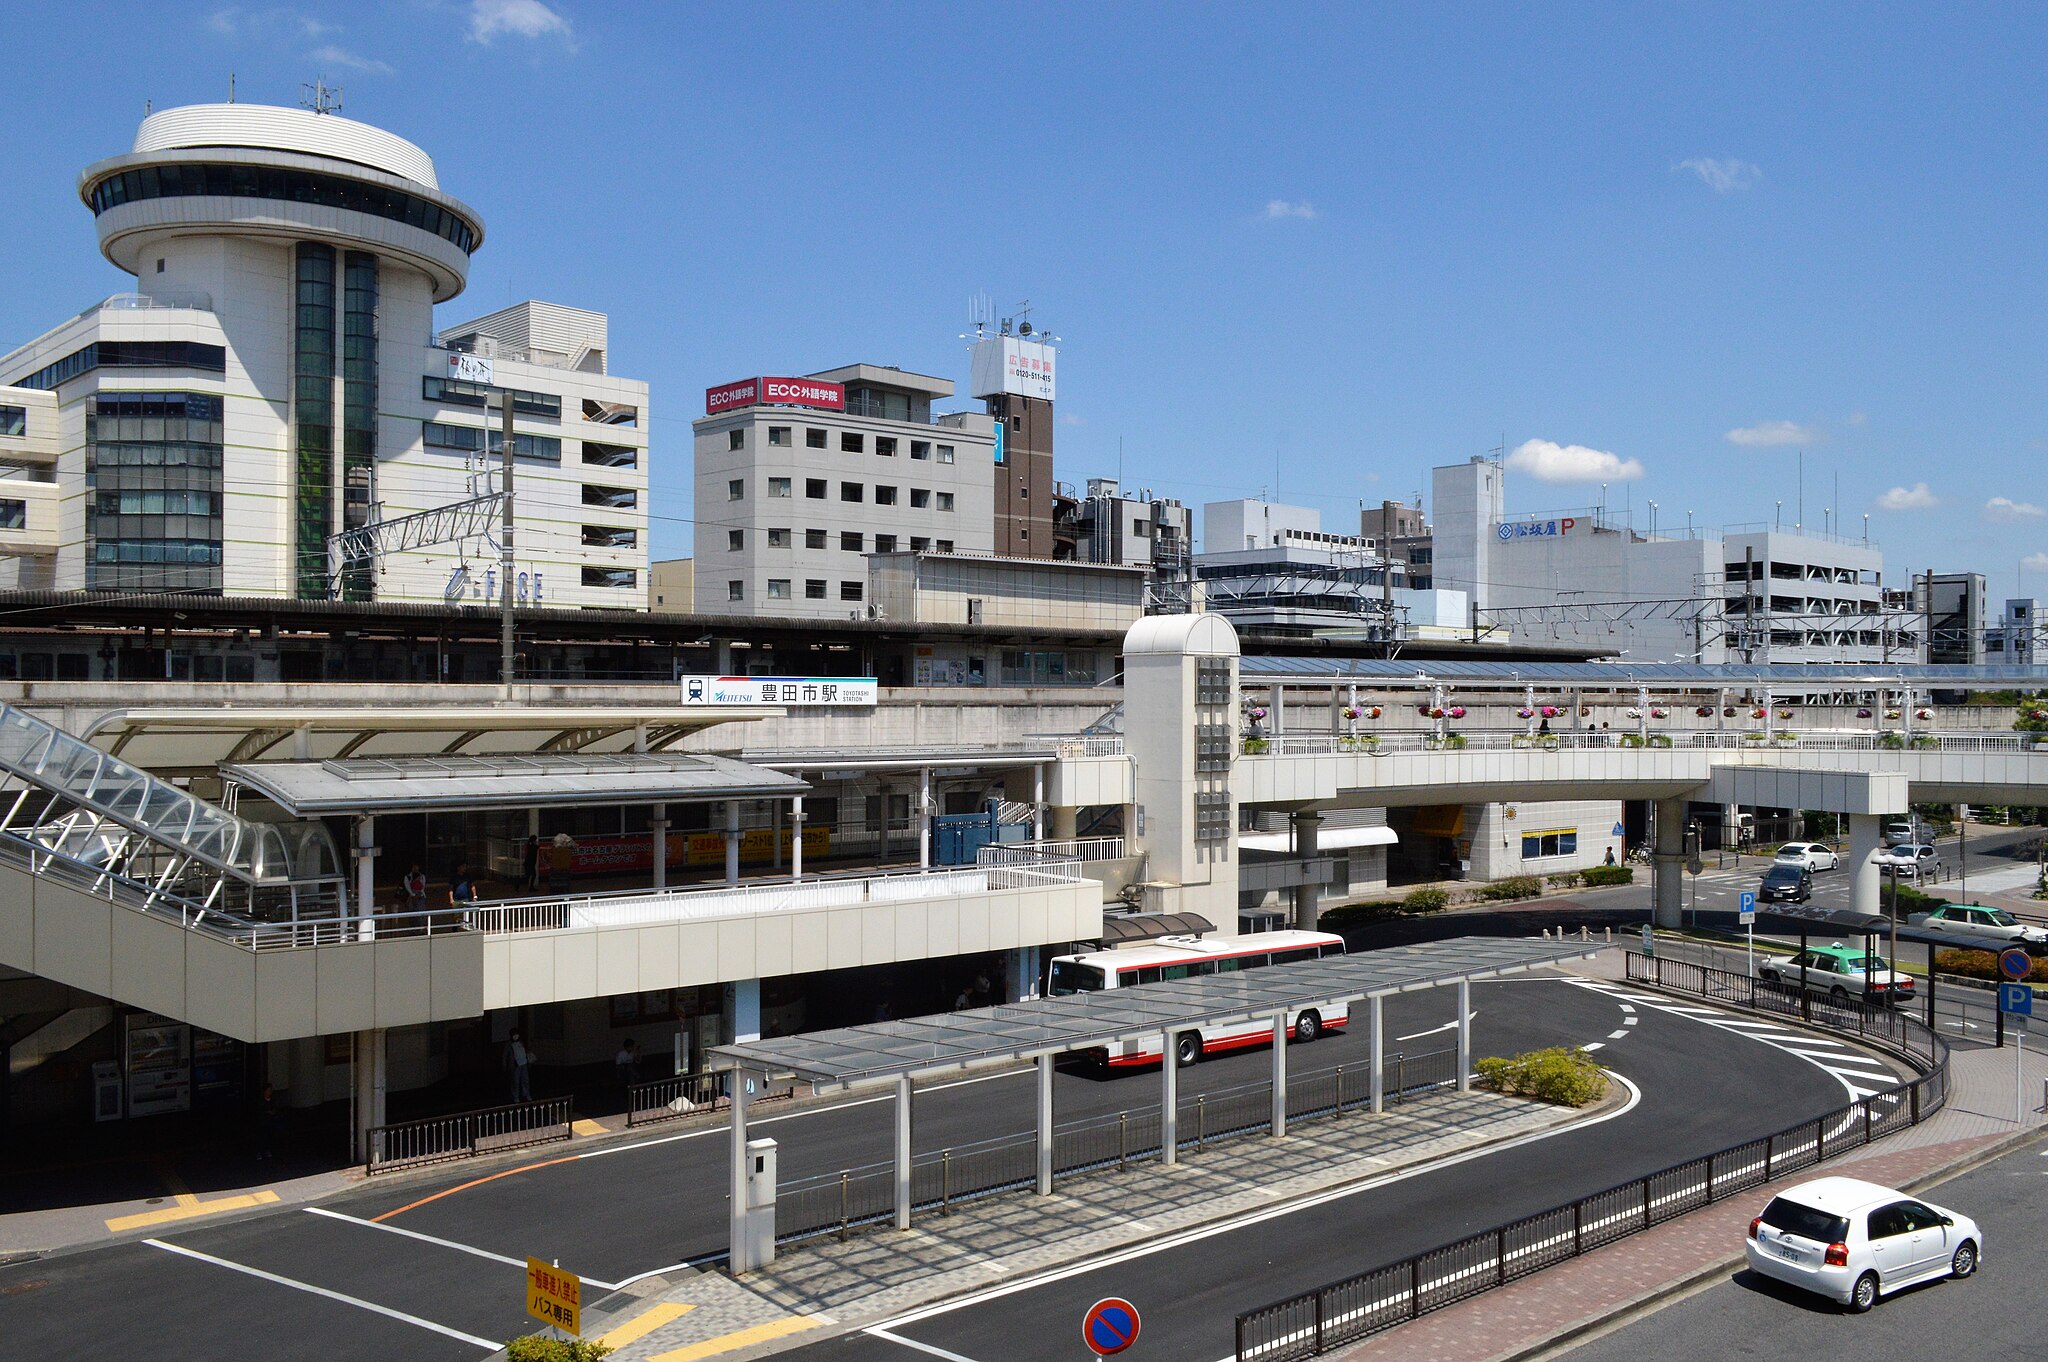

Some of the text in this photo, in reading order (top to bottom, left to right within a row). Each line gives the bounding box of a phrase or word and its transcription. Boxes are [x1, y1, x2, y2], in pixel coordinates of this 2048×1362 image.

[1009, 354, 1052, 373] 広告募集
[710, 386, 754, 406] ECC外語学院
[768, 384, 838, 402] ECC外語学院
[1515, 518, 1575, 537] 松坂屋 P
[486, 571, 543, 600] FCE
[761, 684, 837, 702] 豊田市駅
[1743, 894, 1752, 910] P
[2008, 987, 2026, 1010] P
[529, 1267, 577, 1305] 一般車進入禁止
[534, 1296, 573, 1327] バス専用
